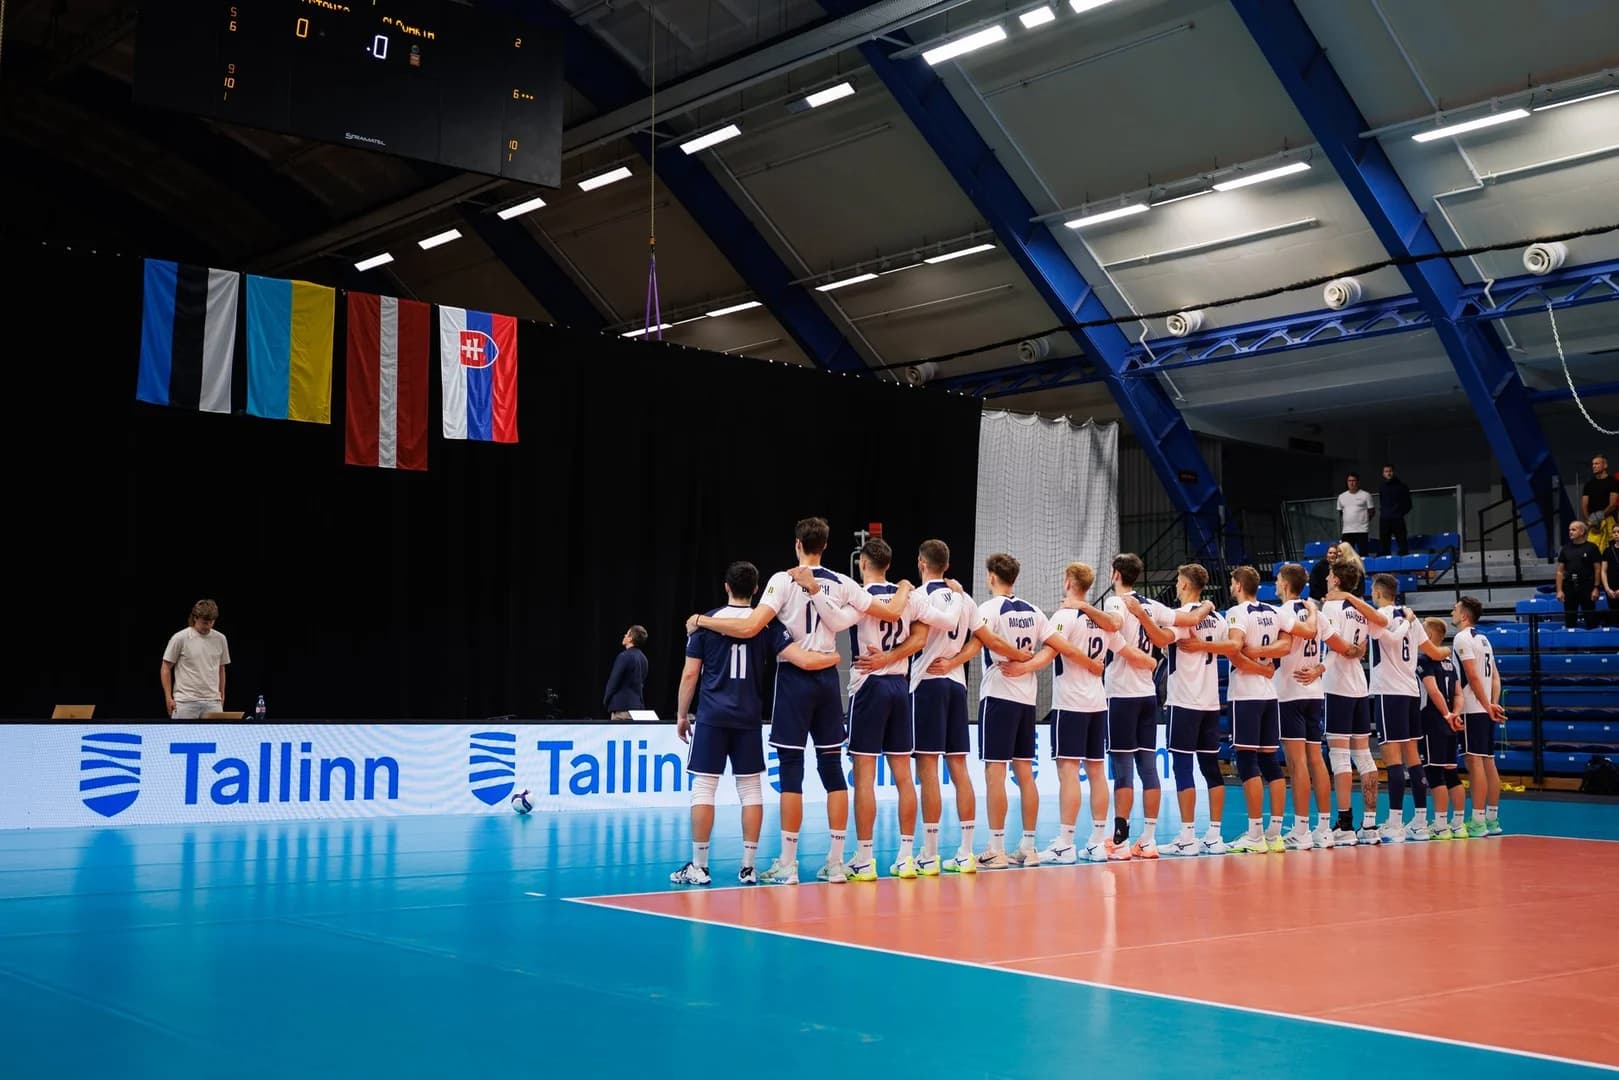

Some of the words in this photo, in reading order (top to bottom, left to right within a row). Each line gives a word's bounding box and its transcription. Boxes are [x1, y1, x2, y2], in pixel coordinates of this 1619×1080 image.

[229, 20, 237, 32] 6
[296, 17, 309, 38] 0
[373, 34, 389, 60] 0
[514, 38, 521, 48] 2
[223, 77, 235, 89] 10
[509, 140, 518, 150] 10
[879, 618, 904, 652] 22
[1087, 636, 1104, 660] 12
[1401, 636, 1410, 662] 6
[730, 643, 747, 679] 11
[169, 741, 400, 806] Tallinn
[536, 739, 693, 796] Tallin
